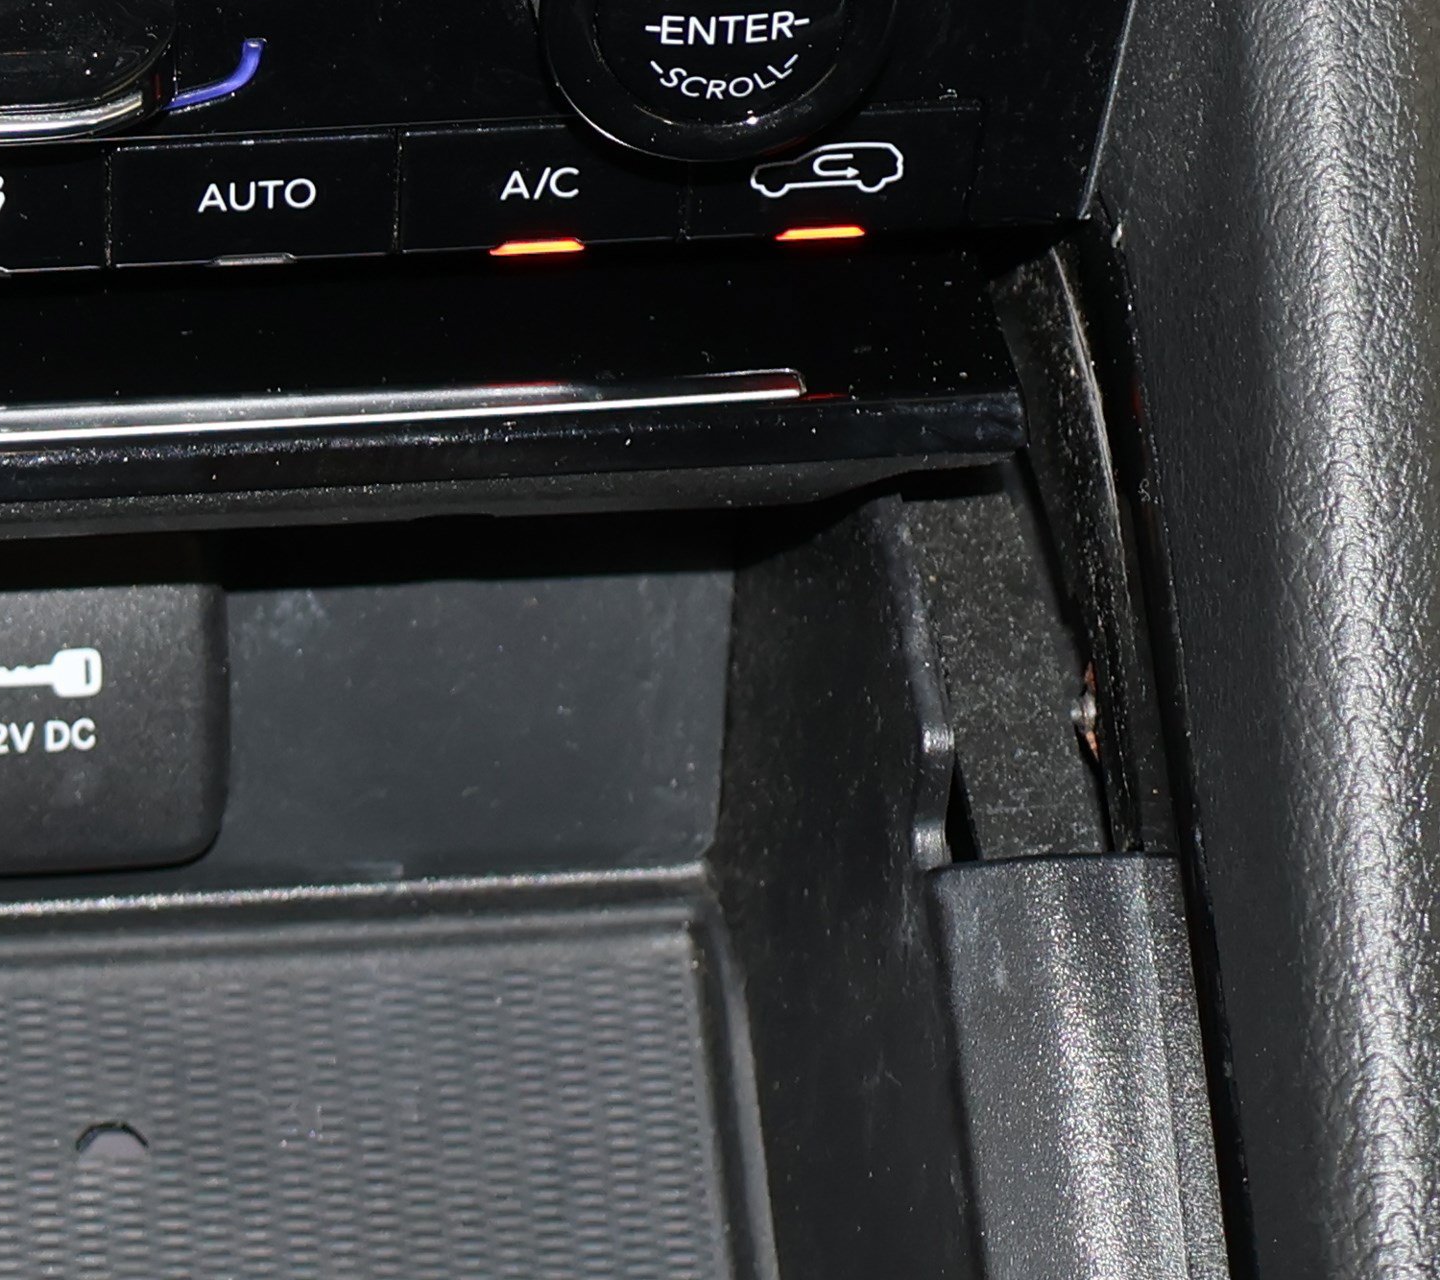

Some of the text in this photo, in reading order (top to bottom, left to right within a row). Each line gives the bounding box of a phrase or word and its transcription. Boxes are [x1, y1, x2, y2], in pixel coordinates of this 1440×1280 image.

[198, 178, 317, 213] AUTO
[500, 166, 579, 201] A/C
[44, 717, 96, 752] DC
